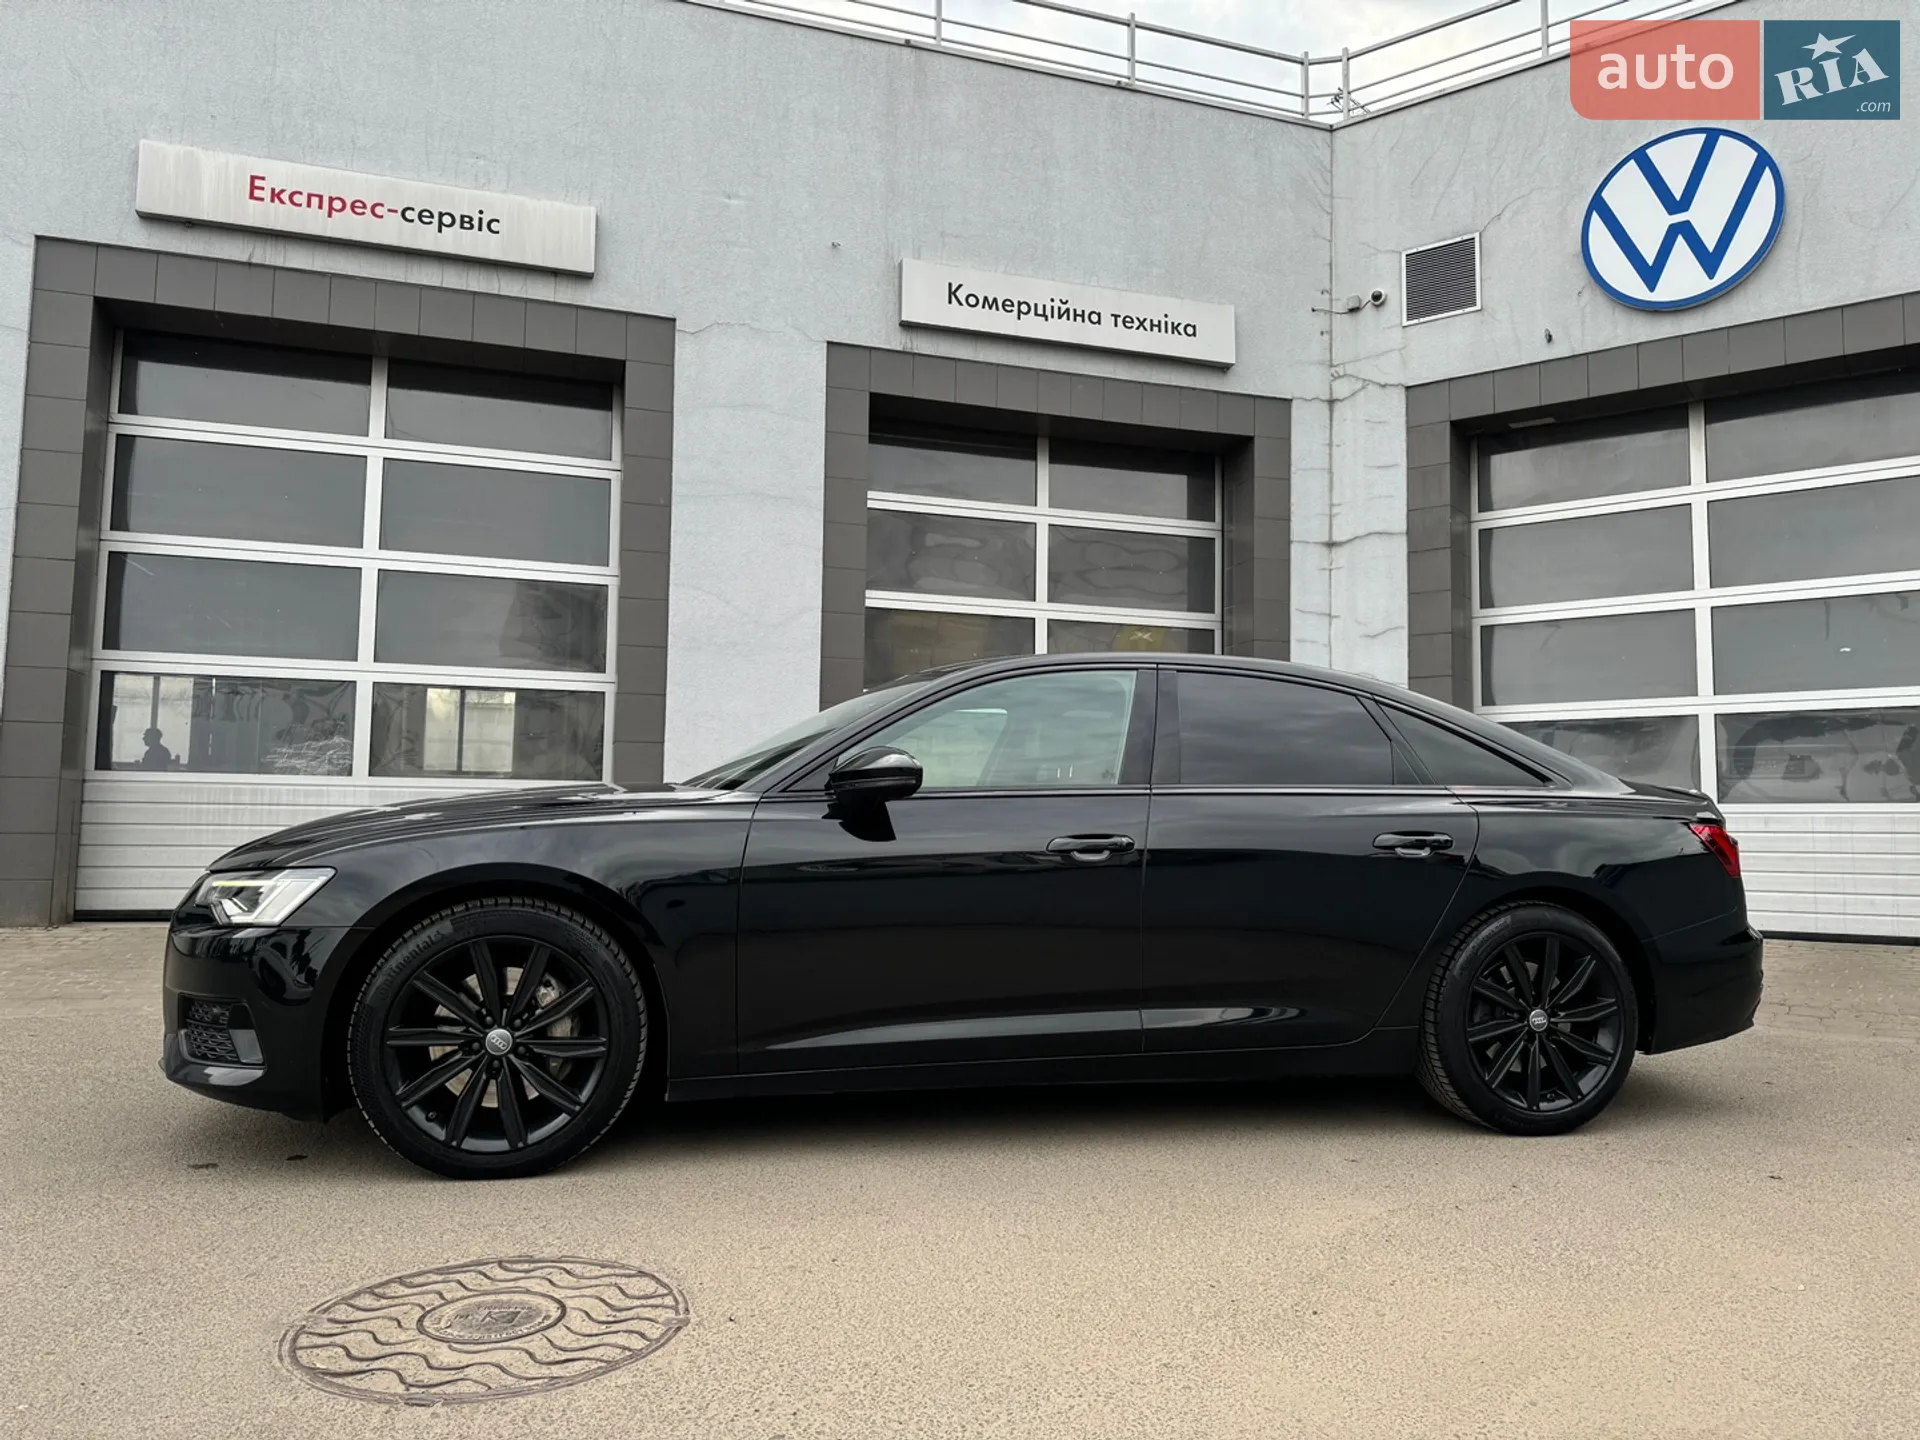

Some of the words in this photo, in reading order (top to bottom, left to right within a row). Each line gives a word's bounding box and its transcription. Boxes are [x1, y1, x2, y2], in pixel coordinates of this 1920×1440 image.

[247, 173, 501, 235] Експрес-сервіс
[947, 281, 1102, 326] Комерційна
[1111, 312, 1198, 338] техніка
